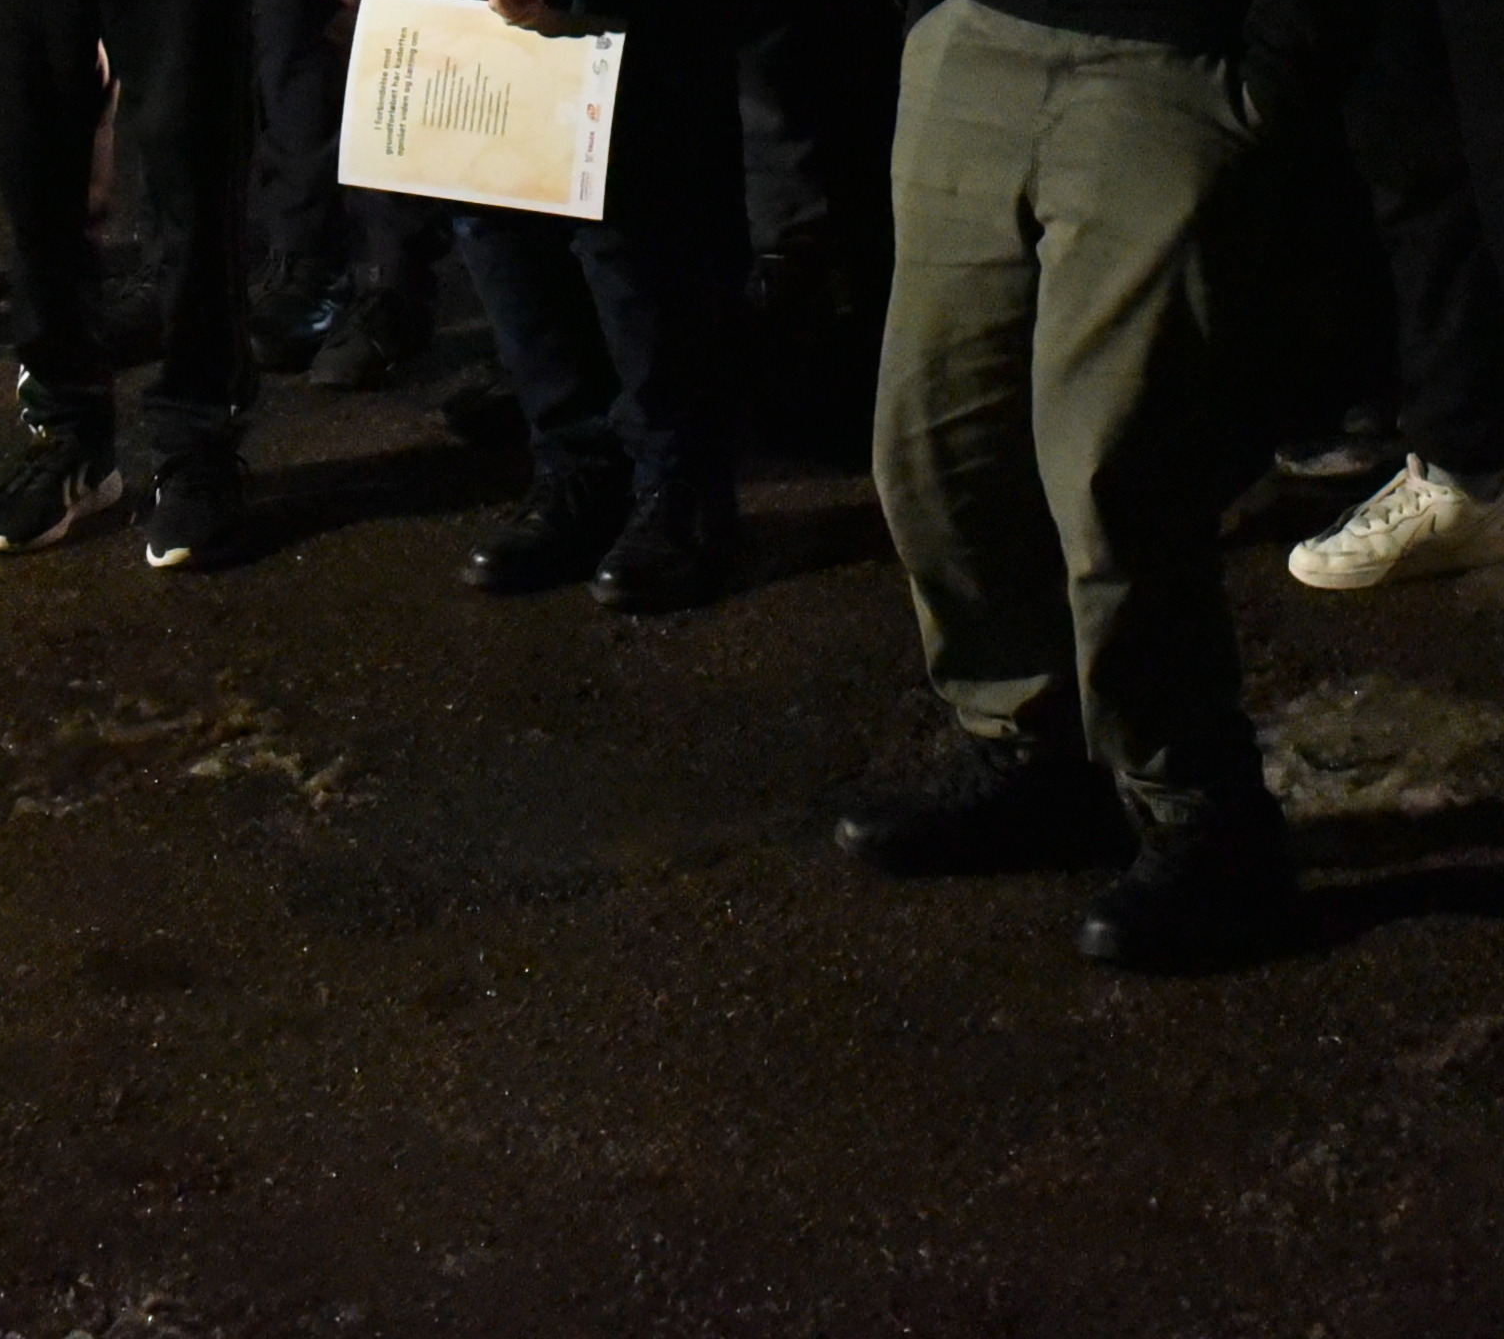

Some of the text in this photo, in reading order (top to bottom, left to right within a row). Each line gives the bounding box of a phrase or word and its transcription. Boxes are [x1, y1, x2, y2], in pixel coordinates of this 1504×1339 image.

[411, 31, 418, 46] om
[392, 72, 400, 87] har
[404, 81, 412, 93] og
[400, 95, 409, 121] viden
